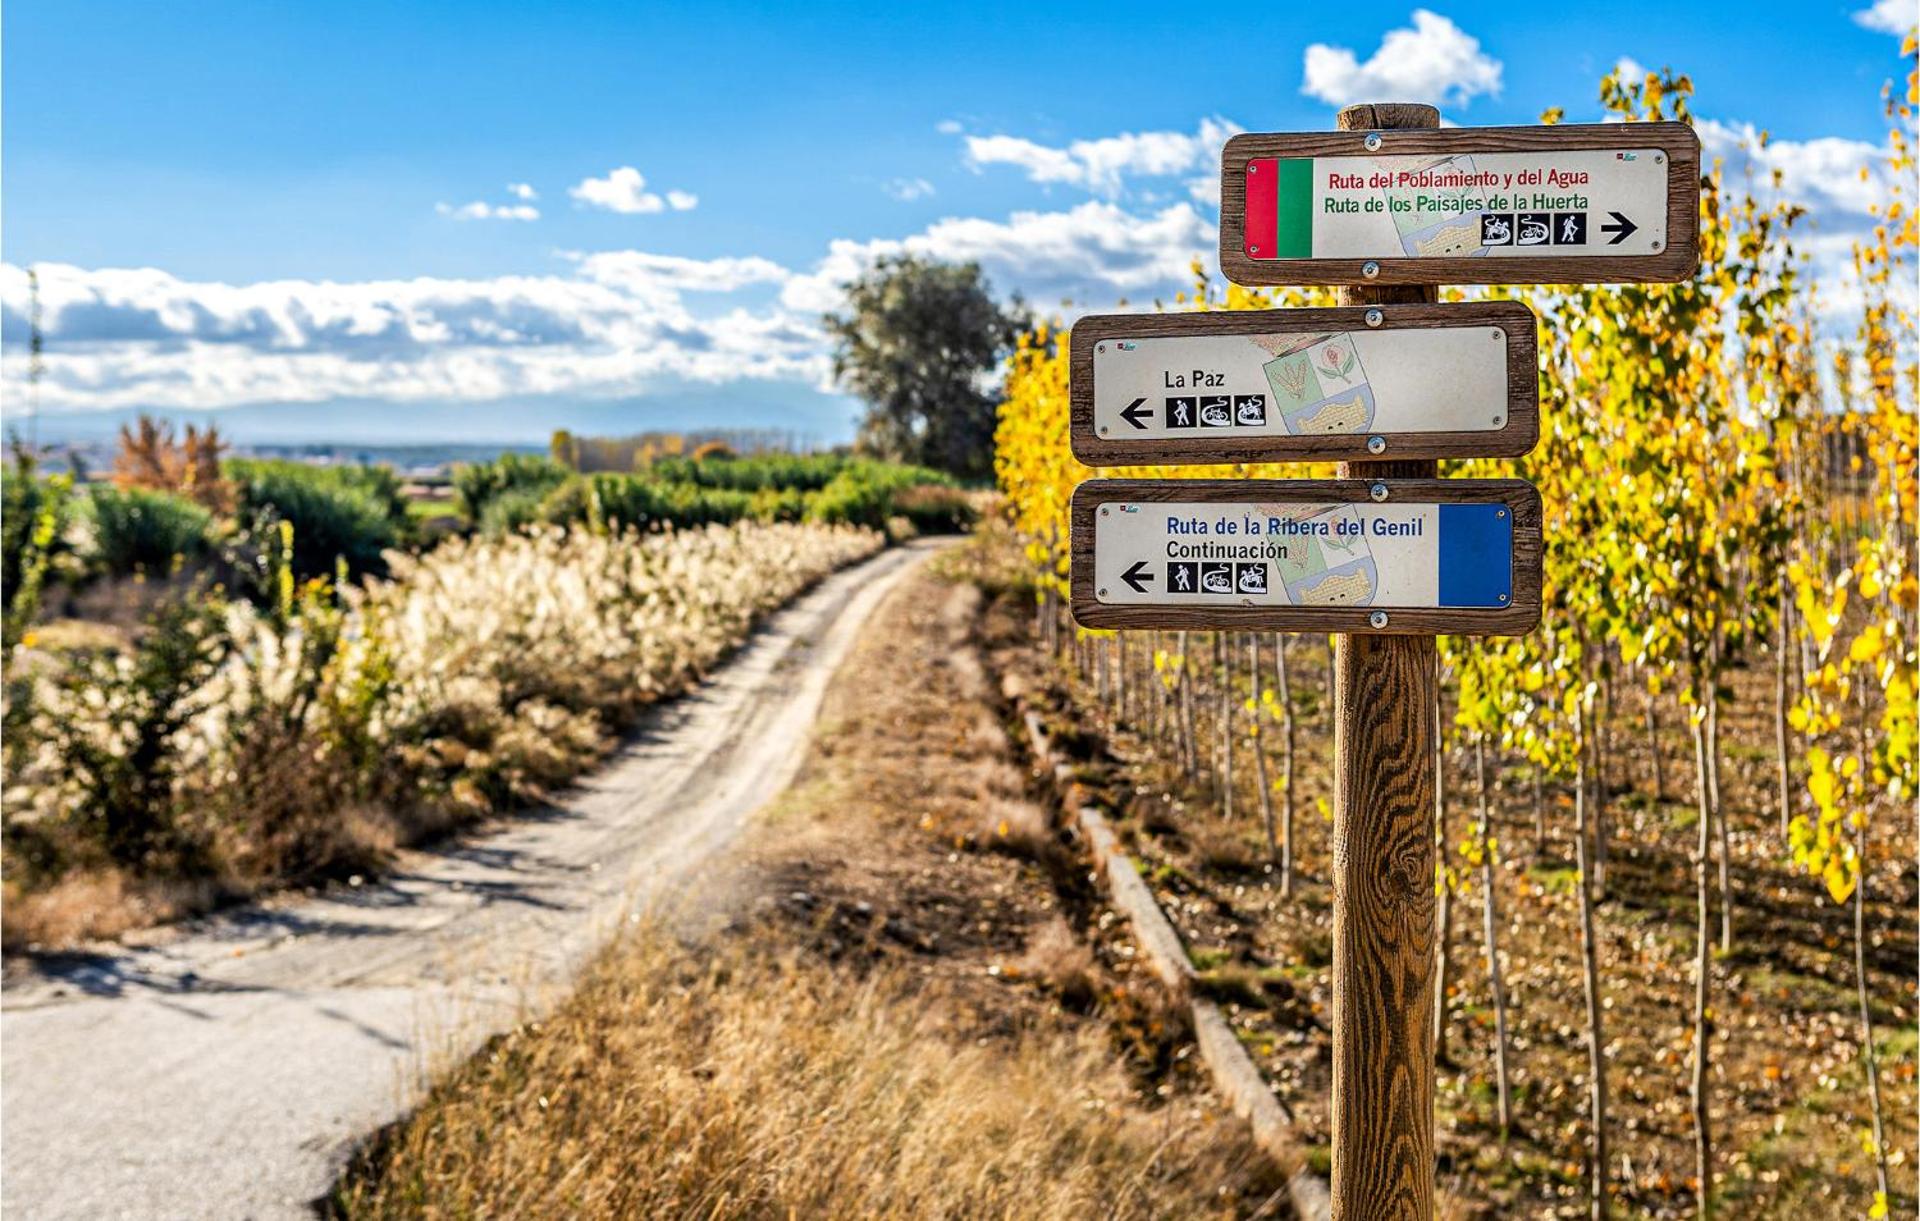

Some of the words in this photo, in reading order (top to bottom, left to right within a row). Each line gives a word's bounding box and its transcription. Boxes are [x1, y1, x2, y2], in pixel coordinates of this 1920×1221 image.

[1329, 172, 1366, 189] Ruta
[1369, 172, 1392, 188] del
[1398, 170, 1499, 188] Poblamiento
[1503, 173, 1512, 189] y
[1517, 170, 1542, 186] del
[1547, 169, 1589, 189] Agua
[1325, 197, 1360, 213] Ruta
[1364, 197, 1384, 212] de
[1389, 196, 1411, 212] los
[1416, 194, 1483, 214] Paisajes
[1488, 195, 1508, 210] de
[1513, 194, 1527, 210] la
[1532, 193, 1588, 210] Huerta
[1164, 371, 1185, 388] La
[1192, 370, 1224, 387] Paz
[1167, 517, 1209, 535] Ruta
[1215, 517, 1237, 535] de
[1244, 517, 1261, 535] la
[1268, 517, 1329, 536] Ribera
[1337, 517, 1365, 536] del
[1372, 517, 1423, 537] Genil
[1166, 541, 1288, 559] Continuación
